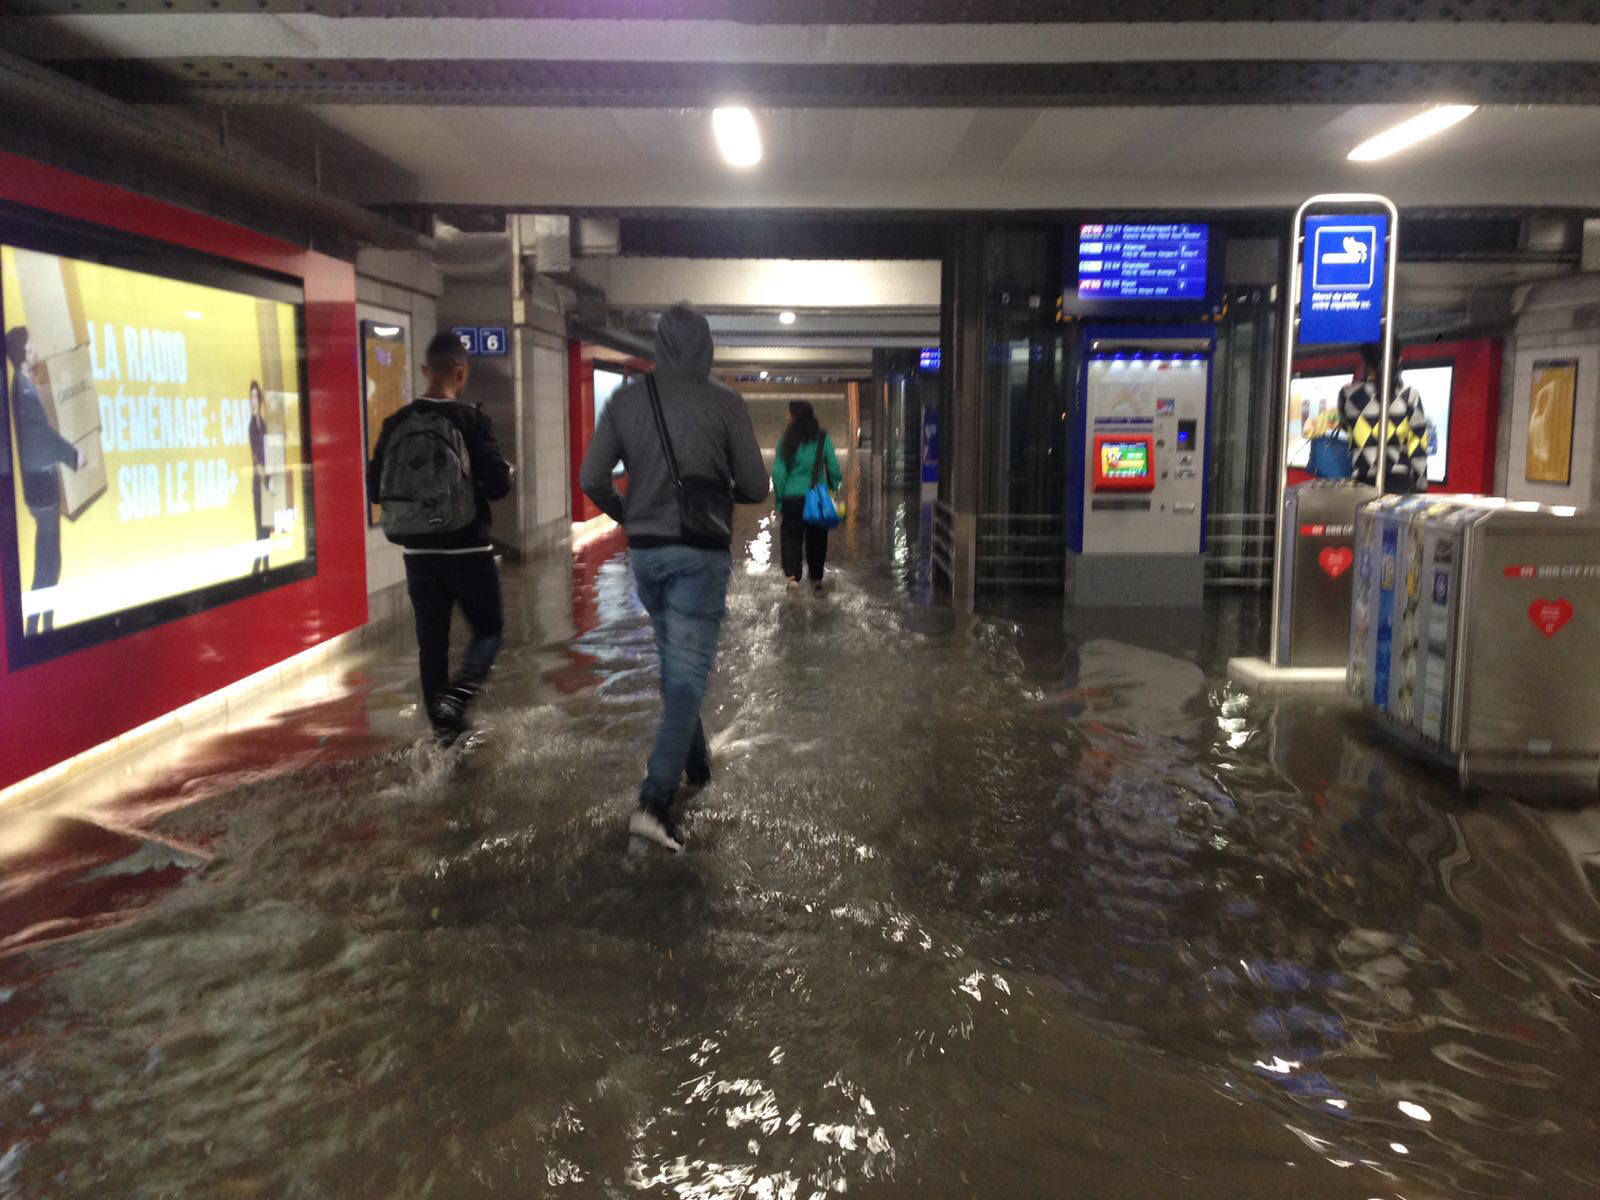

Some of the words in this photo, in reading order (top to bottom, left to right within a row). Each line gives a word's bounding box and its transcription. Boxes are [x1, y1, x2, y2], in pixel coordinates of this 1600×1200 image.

[87, 320, 121, 381] LA
[123, 325, 188, 385] RADIO
[459, 335, 471, 350] 5
[487, 335, 499, 352] 6
[118, 464, 161, 522] SUR
[166, 461, 190, 515] LE
[194, 458, 240, 512] DAB+
